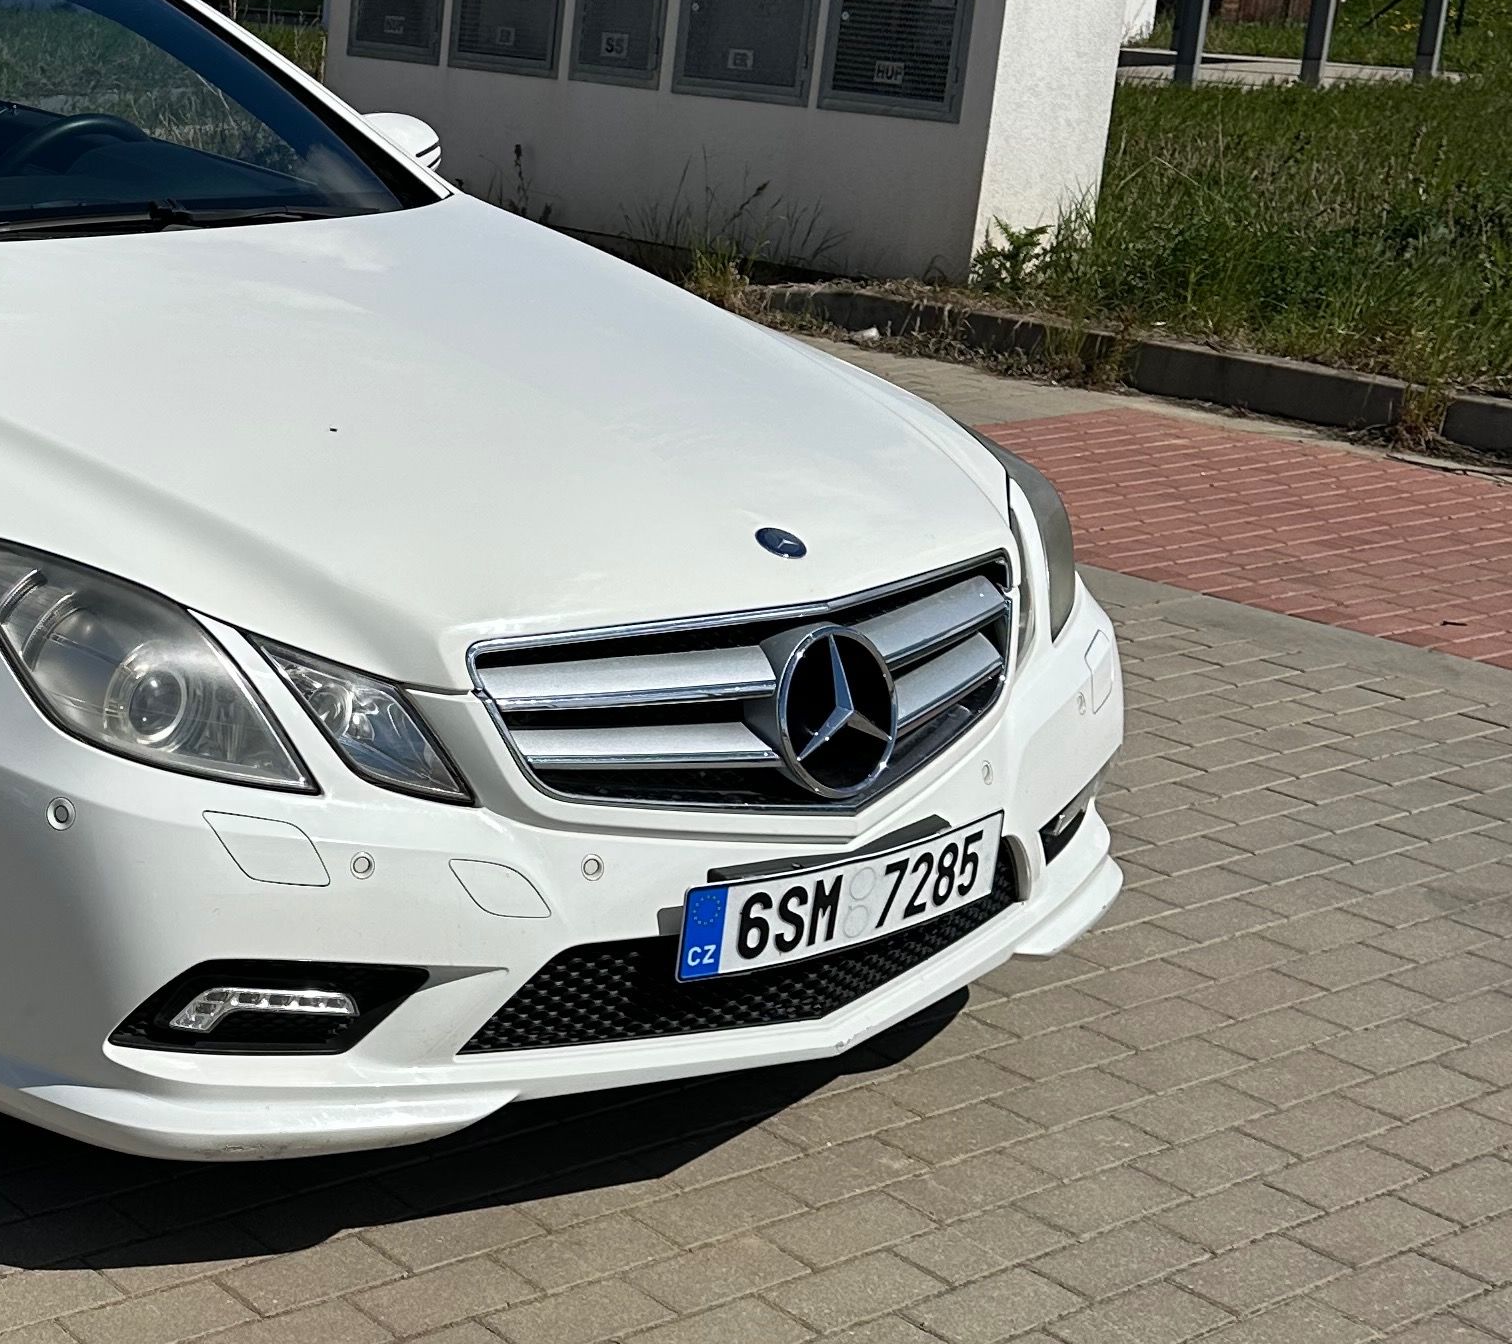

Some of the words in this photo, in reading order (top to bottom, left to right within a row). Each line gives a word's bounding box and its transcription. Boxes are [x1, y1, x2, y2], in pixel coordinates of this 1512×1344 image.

[736, 874, 843, 959] 6SM
[875, 830, 984, 929] 7285
[687, 944, 716, 967] CZ
